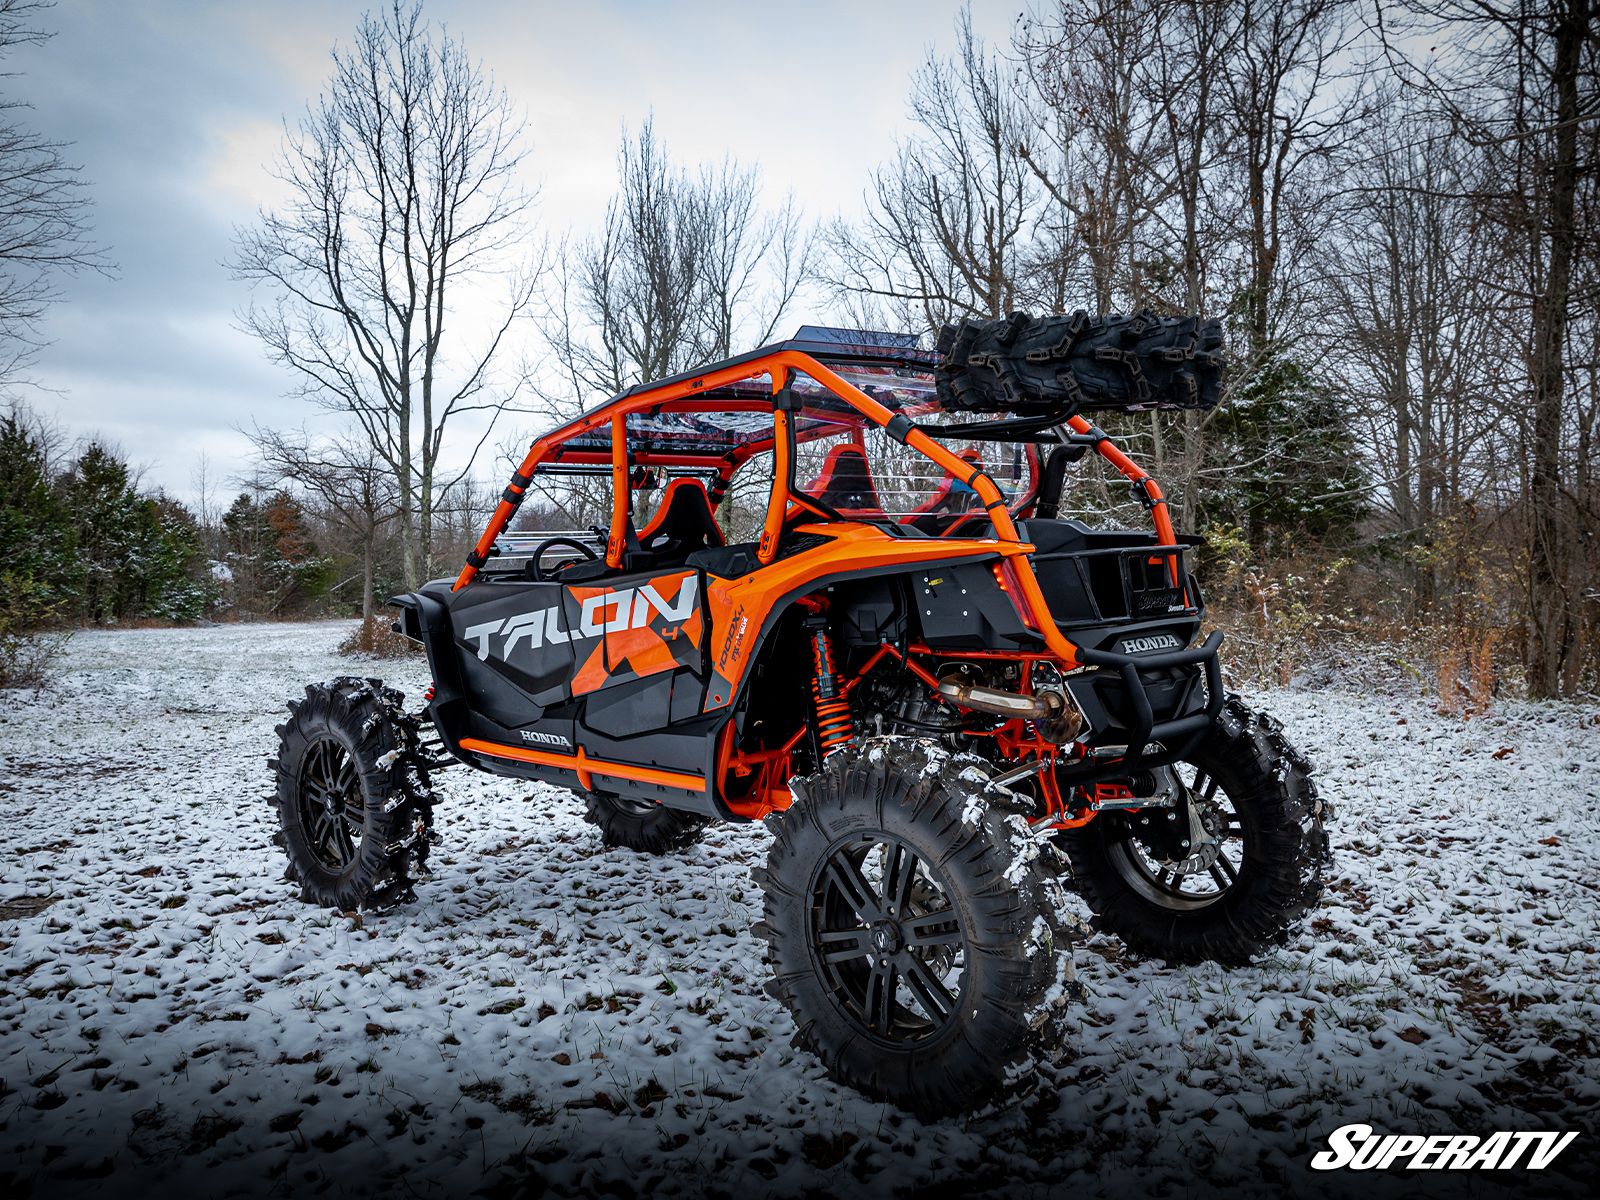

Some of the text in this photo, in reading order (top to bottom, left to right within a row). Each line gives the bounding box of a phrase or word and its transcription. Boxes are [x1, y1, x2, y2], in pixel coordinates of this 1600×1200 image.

[464, 574, 698, 662] TALON
[661, 627, 678, 641] 4
[1121, 634, 1179, 654] HONDA
[519, 730, 573, 747] HONDA
